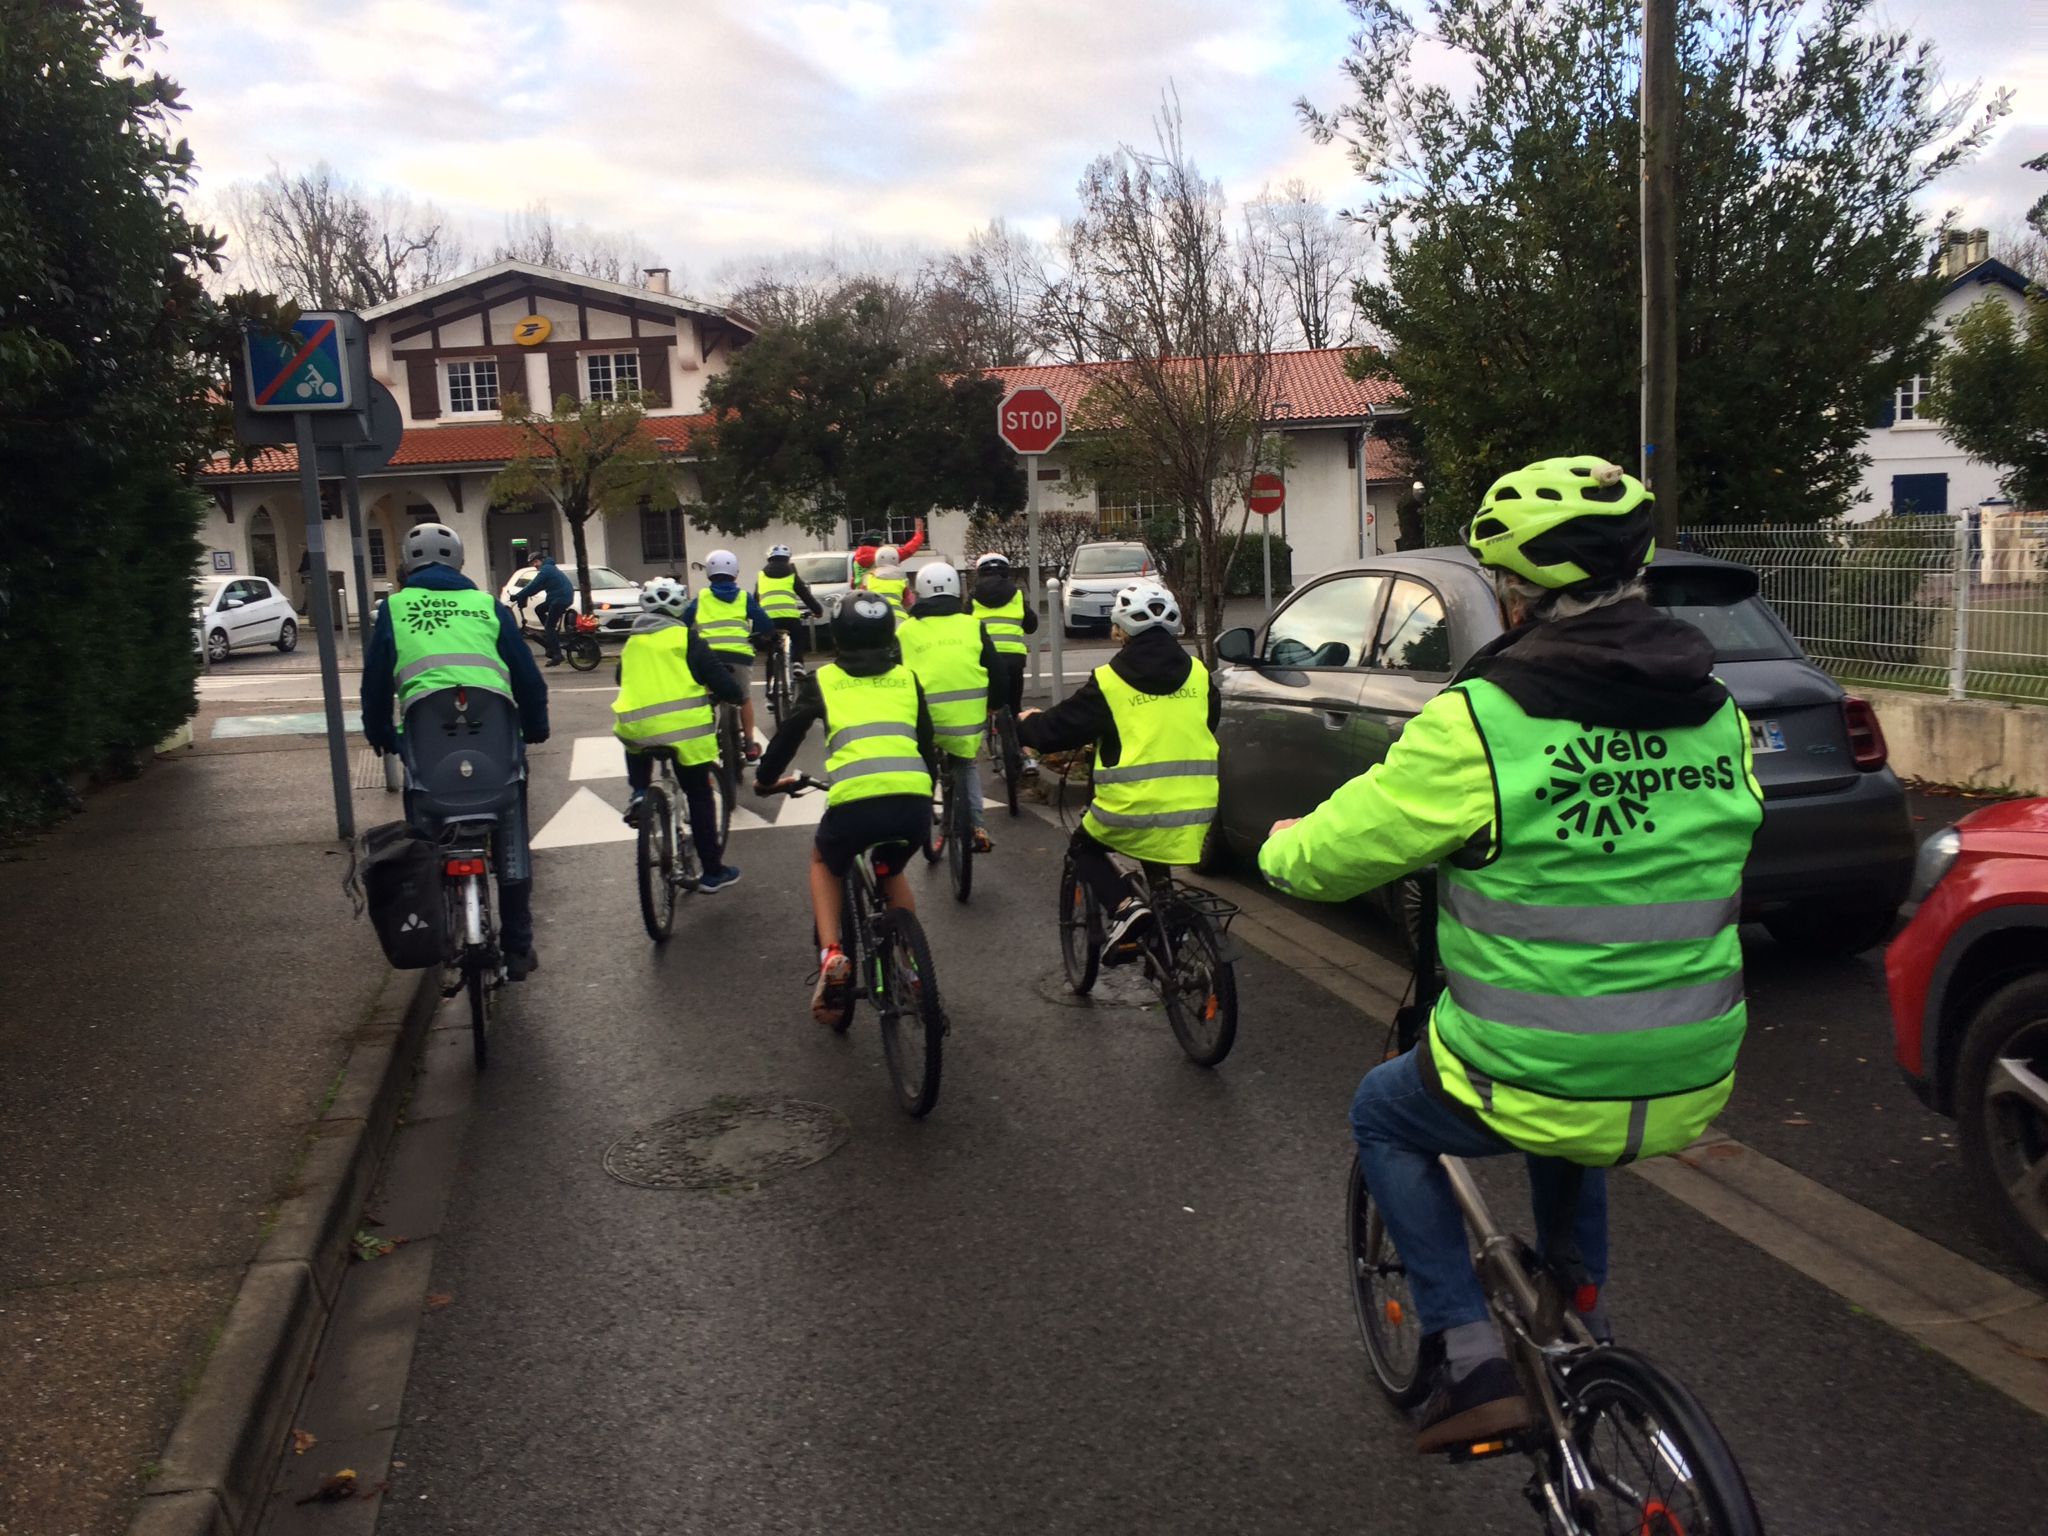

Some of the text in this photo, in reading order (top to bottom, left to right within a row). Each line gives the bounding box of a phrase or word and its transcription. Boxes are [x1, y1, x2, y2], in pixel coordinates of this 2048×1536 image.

[1006, 411, 1058, 430] STOP
[420, 599, 458, 608] Vélo
[1577, 730, 1667, 764] Vélo
